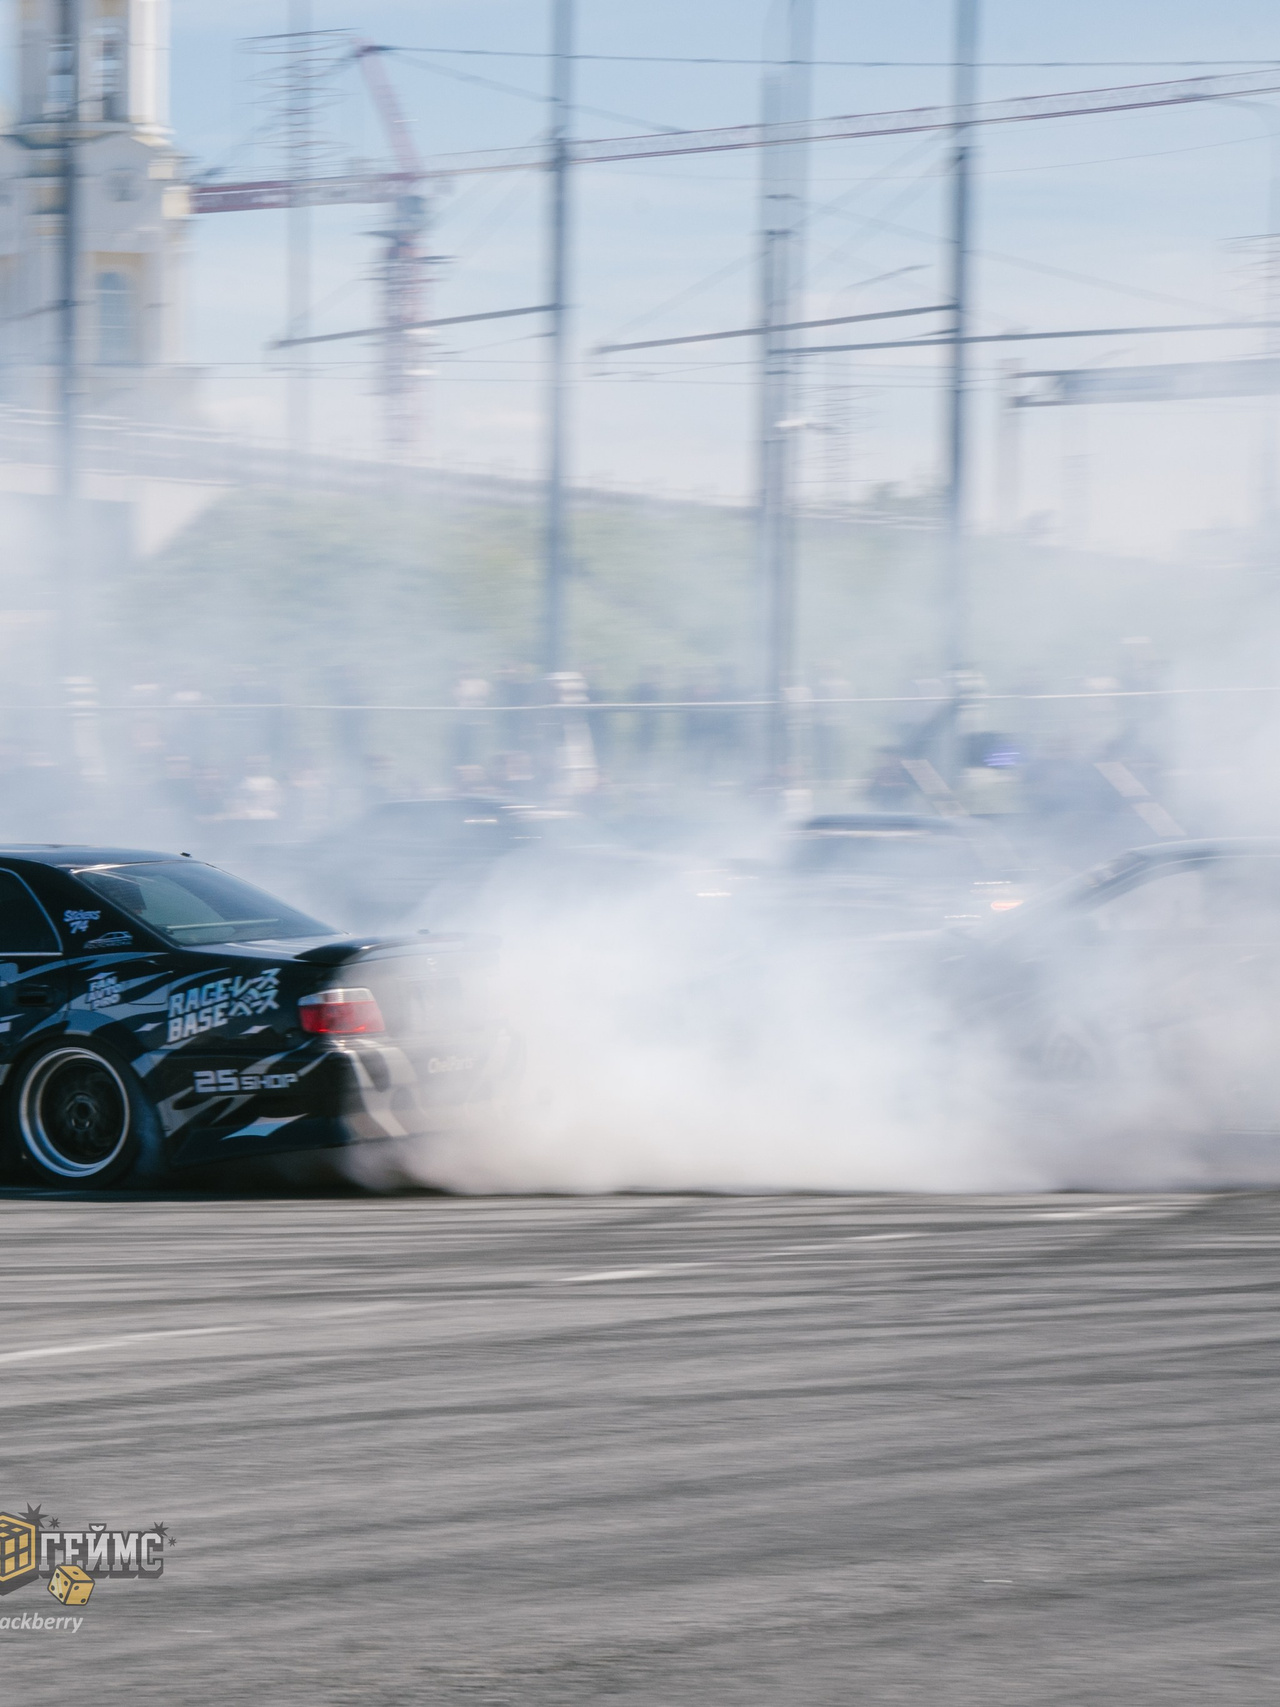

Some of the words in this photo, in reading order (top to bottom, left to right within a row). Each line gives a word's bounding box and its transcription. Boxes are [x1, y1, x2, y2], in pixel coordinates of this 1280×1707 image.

[168, 978, 232, 1018] RACE
[167, 1002, 229, 1043] BASE
[194, 1069, 240, 1092] 25
[240, 1073, 299, 1090] SHOP
